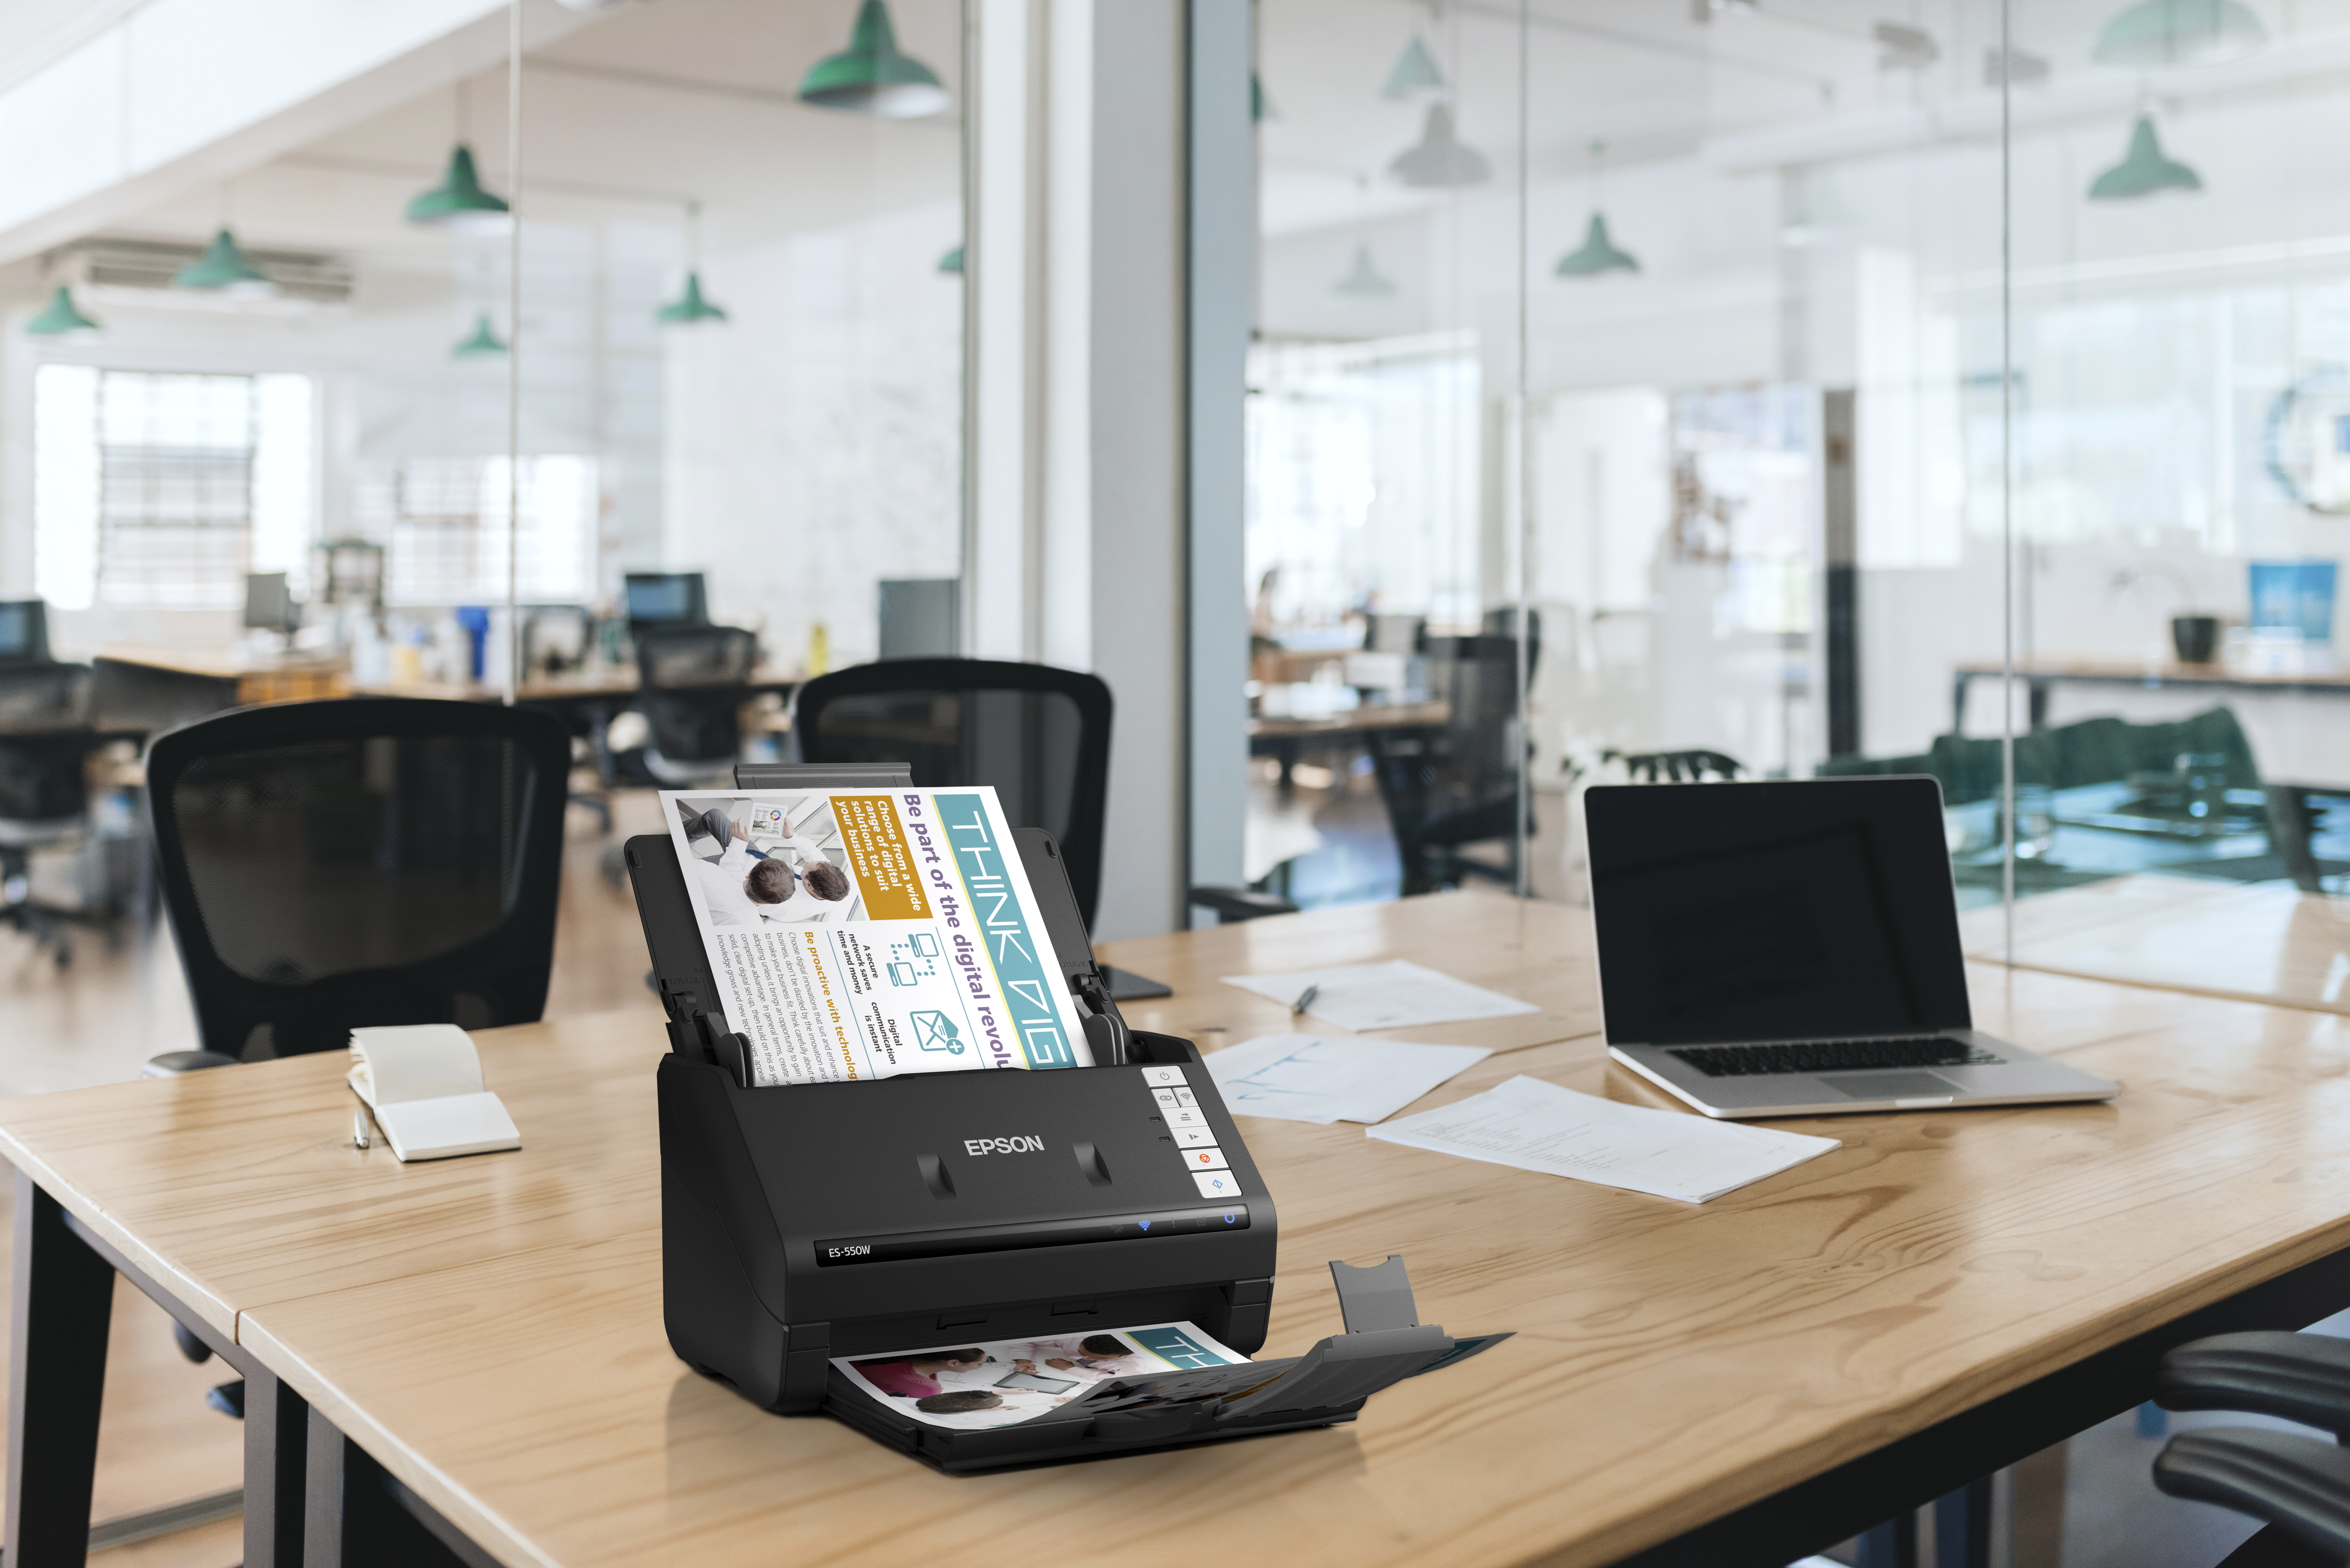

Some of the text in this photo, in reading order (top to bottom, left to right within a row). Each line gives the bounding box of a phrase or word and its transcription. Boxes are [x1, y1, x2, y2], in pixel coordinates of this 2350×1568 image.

[903, 795, 921, 817] Be
[835, 801, 870, 877] your business
[851, 801, 890, 891] solutions to suit
[864, 801, 903, 886] range of digital
[909, 823, 941, 863] part
[878, 801, 896, 840] Choose
[892, 843, 907, 870] from
[906, 883, 922, 911] wide
[930, 869, 953, 890] of
[939, 895, 960, 928] the
[728, 934, 739, 949] solid,
[767, 941, 777, 958] make
[777, 933, 789, 959] business,
[789, 932, 800, 955] Choose
[952, 811, 1070, 1070] THINK DIG
[716, 935, 731, 968] knowledge
[734, 951, 743, 966] clear
[837, 930, 862, 994] time and money
[771, 959, 782, 973] your
[786, 961, 796, 977] don’t
[796, 956, 808, 974] digital
[849, 934, 872, 991] network saves
[866, 953, 878, 978] secure
[953, 934, 991, 999] digital
[725, 970, 737, 989] grows
[739, 967, 751, 985] digital
[777, 974, 790, 999] business
[791, 978, 798, 986] be
[733, 990, 744, 1002] and
[744, 987, 755, 1008] set-up,
[794, 987, 807, 1010] dazzled
[802, 976, 818, 1011] innovations
[737, 1004, 746, 1017] new
[740, 934, 756, 968] competitive
[752, 970, 766, 1003] advantage.
[763, 1012, 778, 1035] general
[772, 1037, 782, 1056] terms,
[779, 1058, 789, 1077] create
[752, 933, 765, 960] adopting
[761, 962, 772, 980] unless
[769, 987, 780, 1006] brings
[778, 1017, 794, 1053] opportunity
[791, 1063, 802, 1077] gain
[804, 932, 858, 1081] Be proactive with technolog
[752, 1009, 760, 1024] then
[789, 1010, 800, 1028] Think
[814, 1012, 823, 1024] that
[756, 1025, 768, 1041] build
[795, 1029, 808, 1055] carefully
[818, 1026, 827, 1037] suit
[867, 1024, 882, 1052] instant
[871, 1002, 896, 1064] communication
[887, 1019, 903, 1046] Digital
[762, 1042, 769, 1051] on
[808, 1033, 823, 1065] innovation
[822, 1038, 832, 1050] and
[765, 1052, 773, 1064] this
[803, 1056, 814, 1075] about
[826, 1052, 839, 1079] enhance
[752, 1060, 766, 1081] appear
[769, 1073, 779, 1085] you
[819, 1067, 829, 1079] and
[964, 1135, 1045, 1156] EPSON
[829, 1245, 870, 1258] ES-550W
